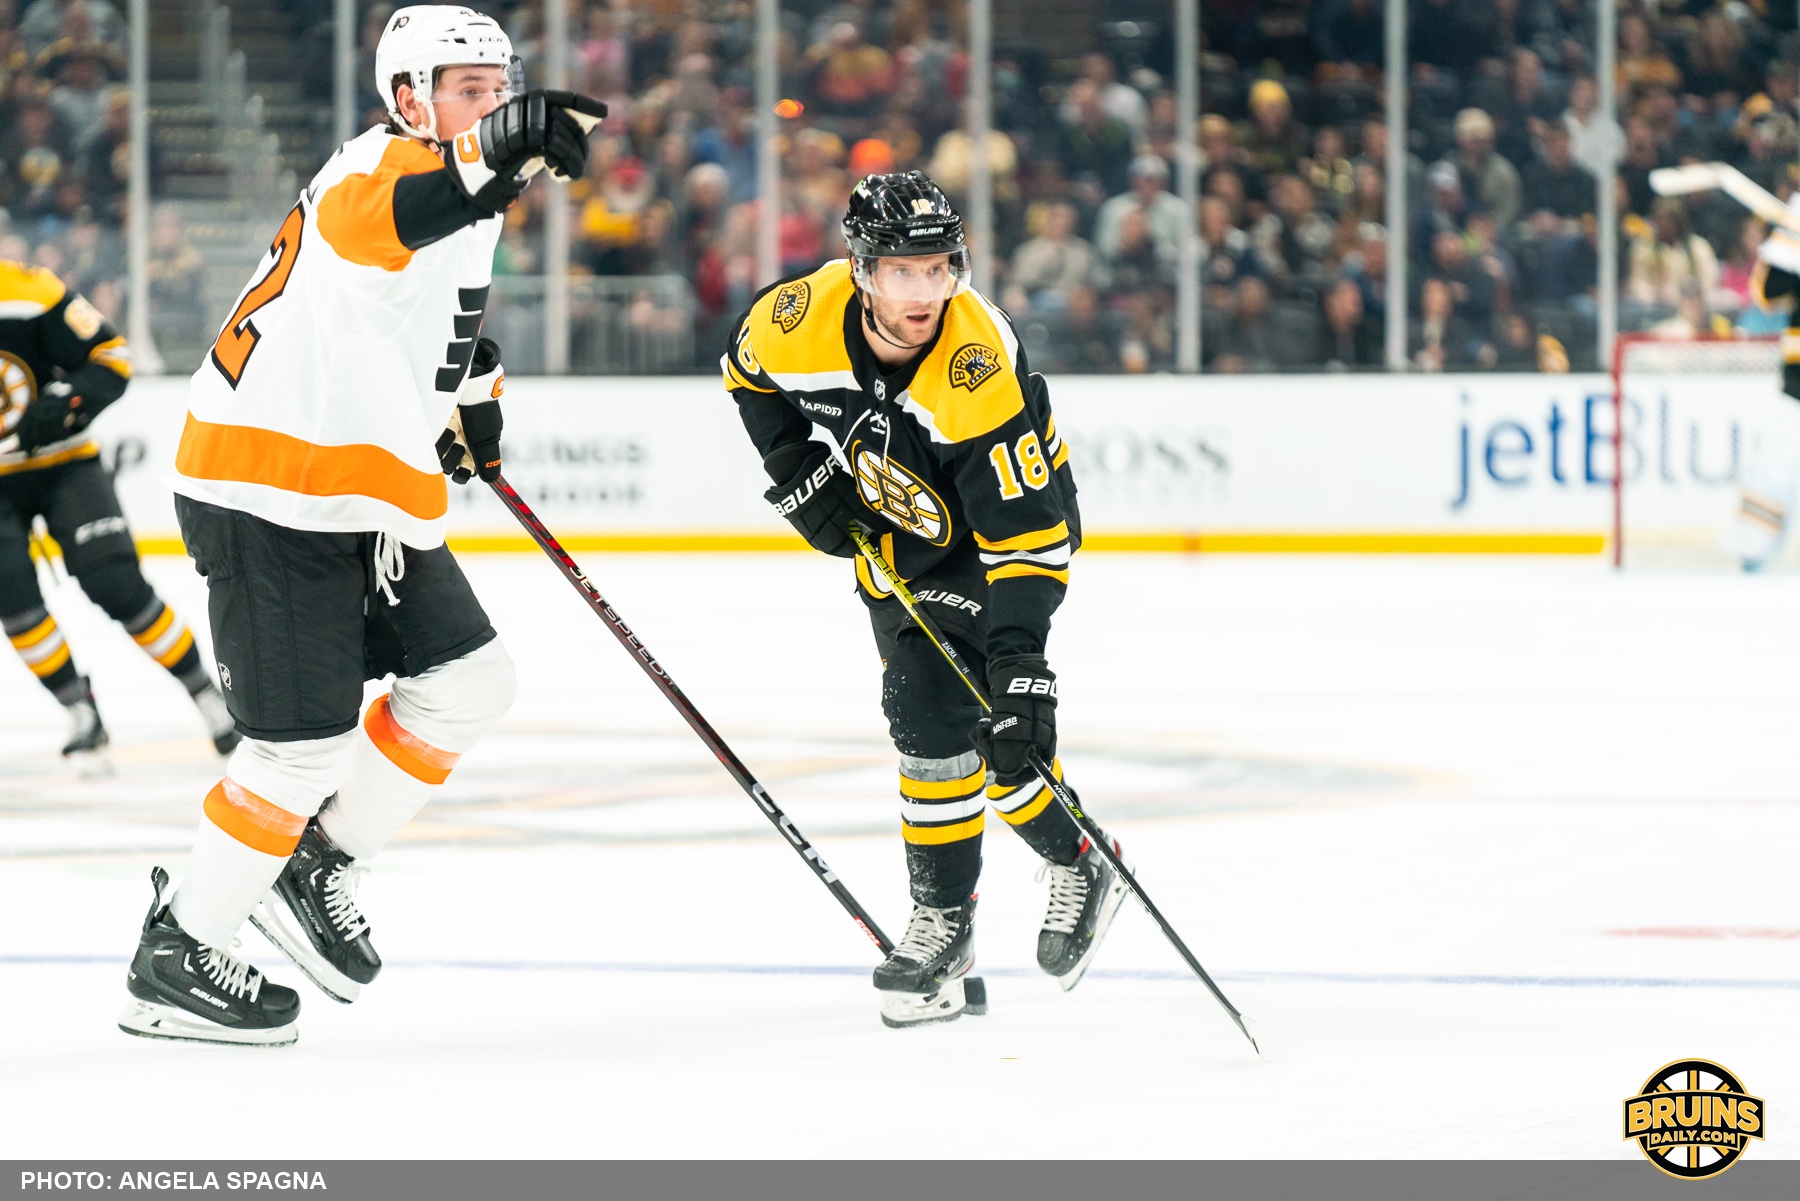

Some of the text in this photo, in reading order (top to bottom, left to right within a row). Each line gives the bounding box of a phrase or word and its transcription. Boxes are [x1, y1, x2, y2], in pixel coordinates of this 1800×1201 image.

[910, 198, 932, 215] 18
[909, 227, 944, 237] BAUER
[783, 283, 806, 327] BRUINS
[953, 347, 994, 382] BRUINS
[799, 397, 843, 417] RAPID7
[989, 430, 1050, 500] 18
[1448, 390, 1741, 511] jetBlu
[773, 453, 842, 516] BAUER
[569, 566, 664, 677] JETSPEED
[1053, 784, 1084, 819] HYPERLITE
[752, 782, 839, 883] CCM
[189, 986, 229, 1010] BAUER
